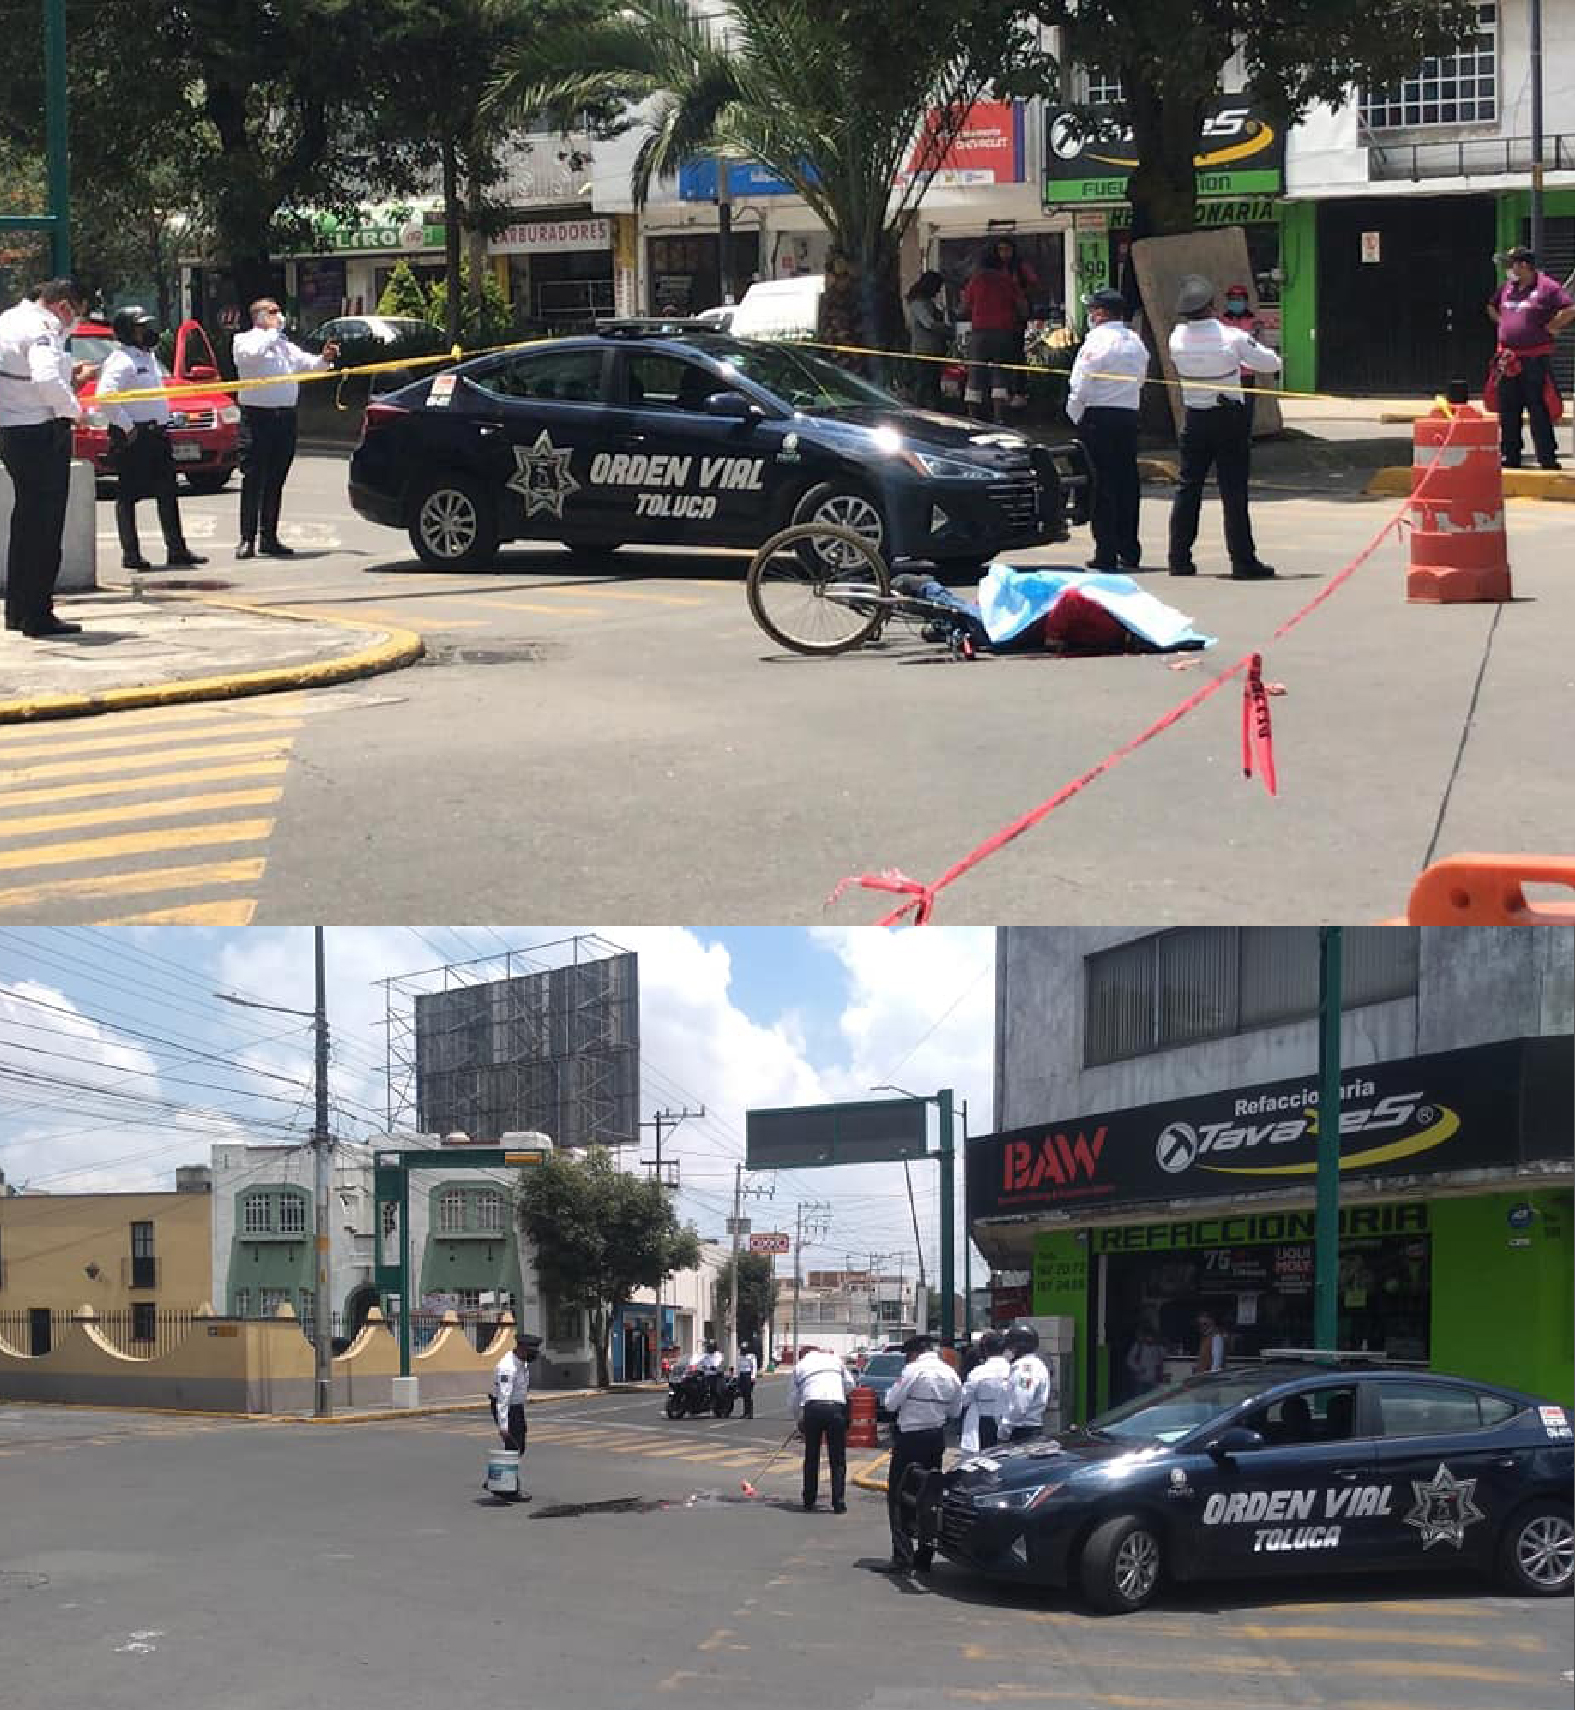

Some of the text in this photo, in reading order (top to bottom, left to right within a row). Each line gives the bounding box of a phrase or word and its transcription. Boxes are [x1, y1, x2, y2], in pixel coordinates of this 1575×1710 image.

[589, 453, 764, 490] ORDEN VIAL
[636, 493, 717, 519] TOLUCA
[1234, 1078, 1375, 1116] Refaccioria
[1004, 1125, 1109, 1191] BAW
[1102, 1205, 1427, 1250] REFACCIONRIA
[1203, 1486, 1392, 1525] ORDEN VIAL
[1254, 1526, 1342, 1552] TOLUCA
